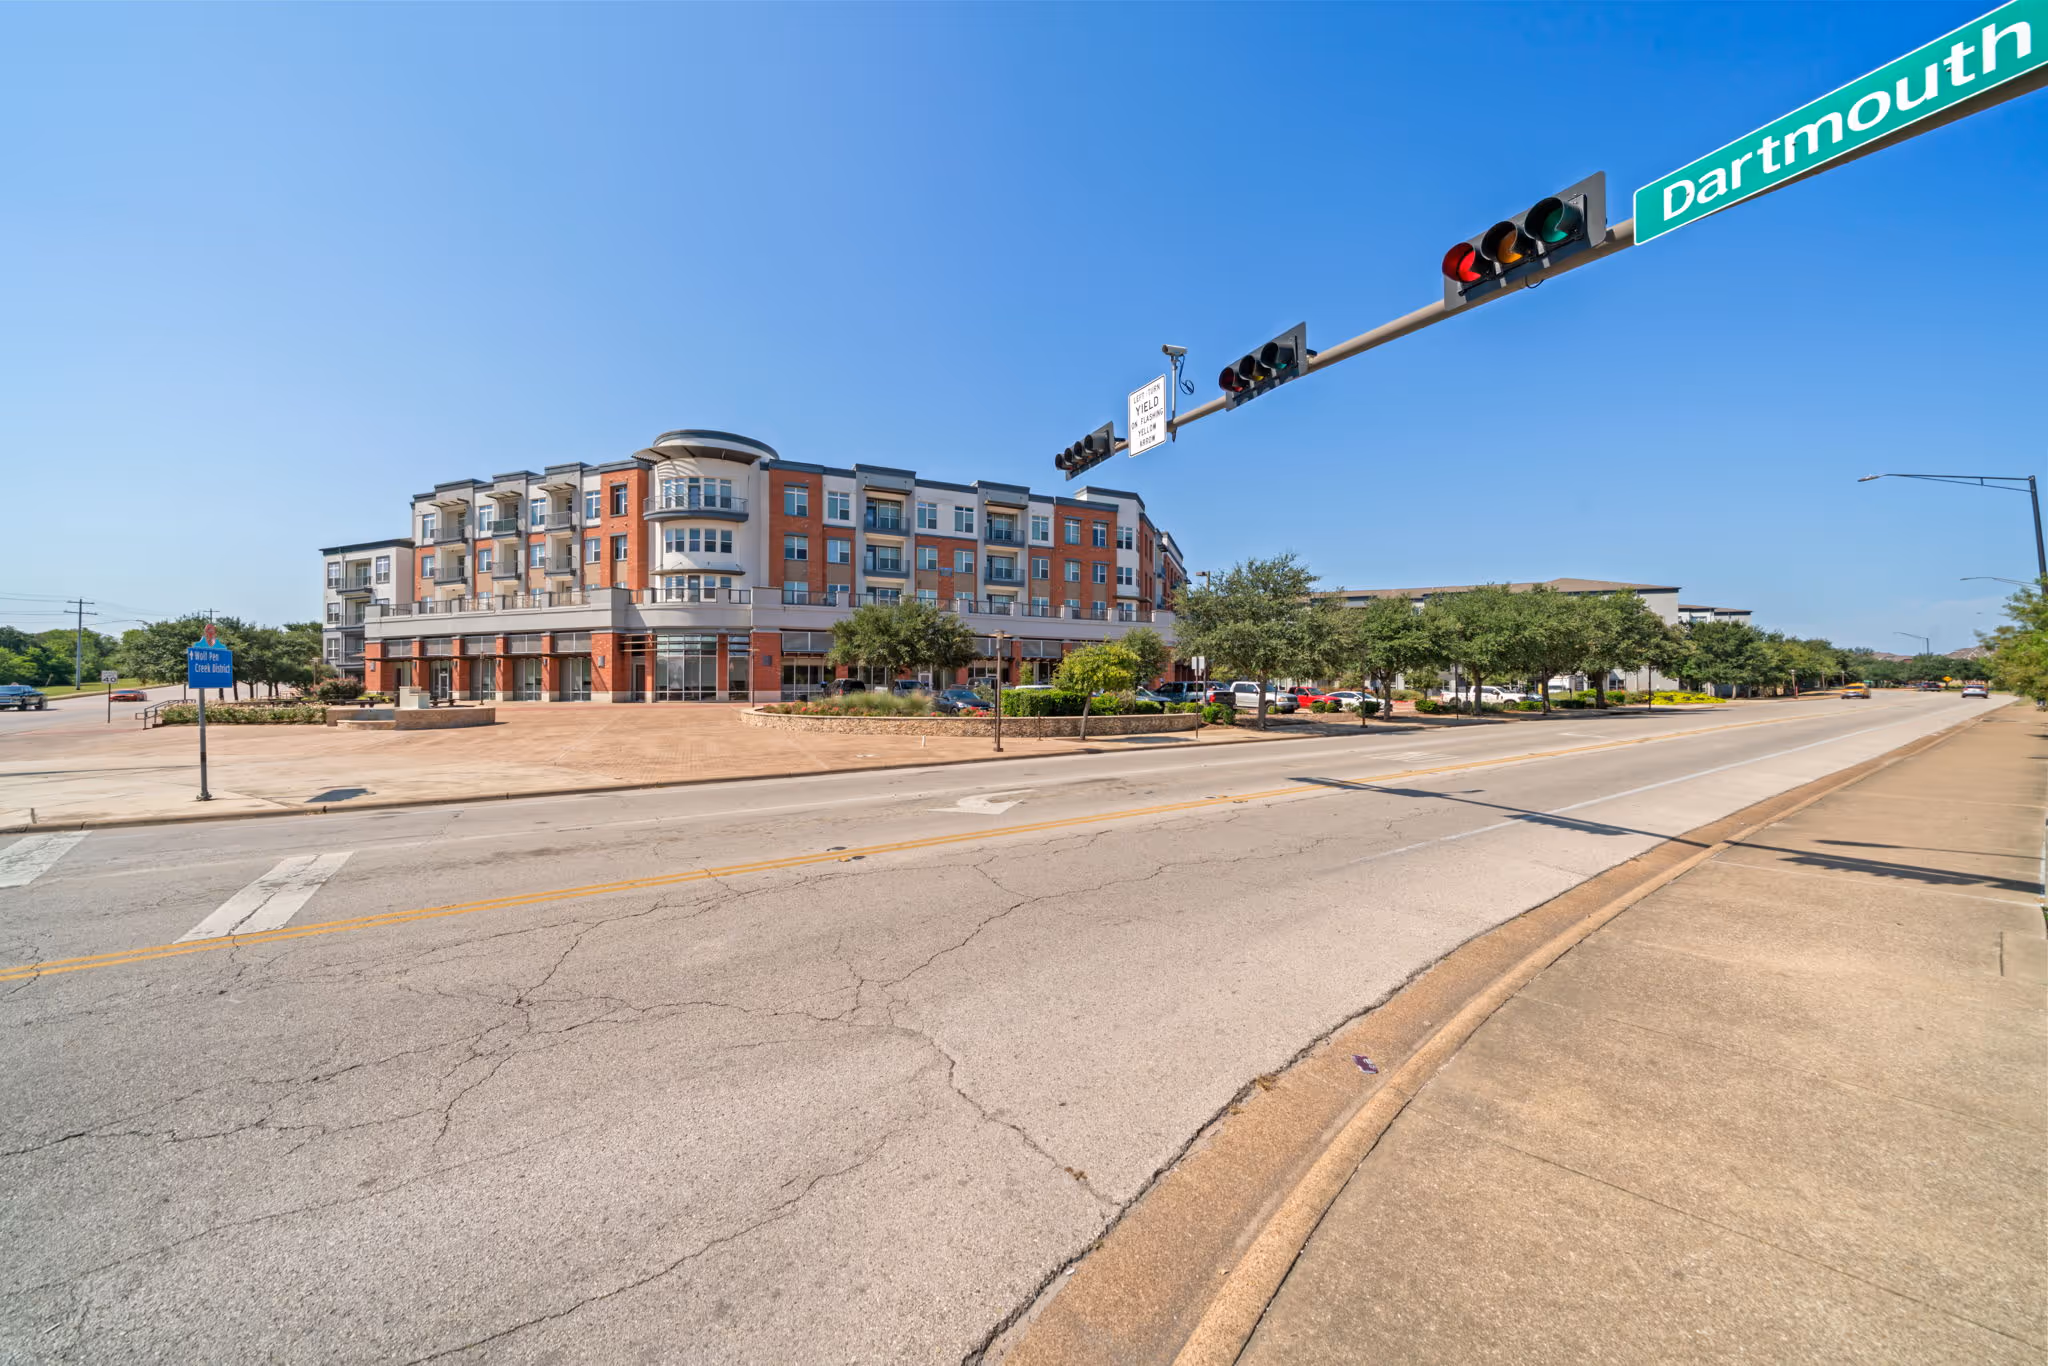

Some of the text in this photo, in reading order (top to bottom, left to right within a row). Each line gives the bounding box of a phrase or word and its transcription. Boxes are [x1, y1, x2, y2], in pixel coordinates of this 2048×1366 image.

[1663, 21, 2032, 221] Dartmouth
[1133, 383, 1161, 405] LEFT TURN
[1135, 396, 1159, 416] YIELD
[1131, 407, 1164, 430] ON FLASHING
[1138, 423, 1156, 437] YELLOW
[1139, 435, 1156, 448] ARROW
[194, 651, 220, 661] Wolf Pen
[194, 663, 231, 673] Creek District
